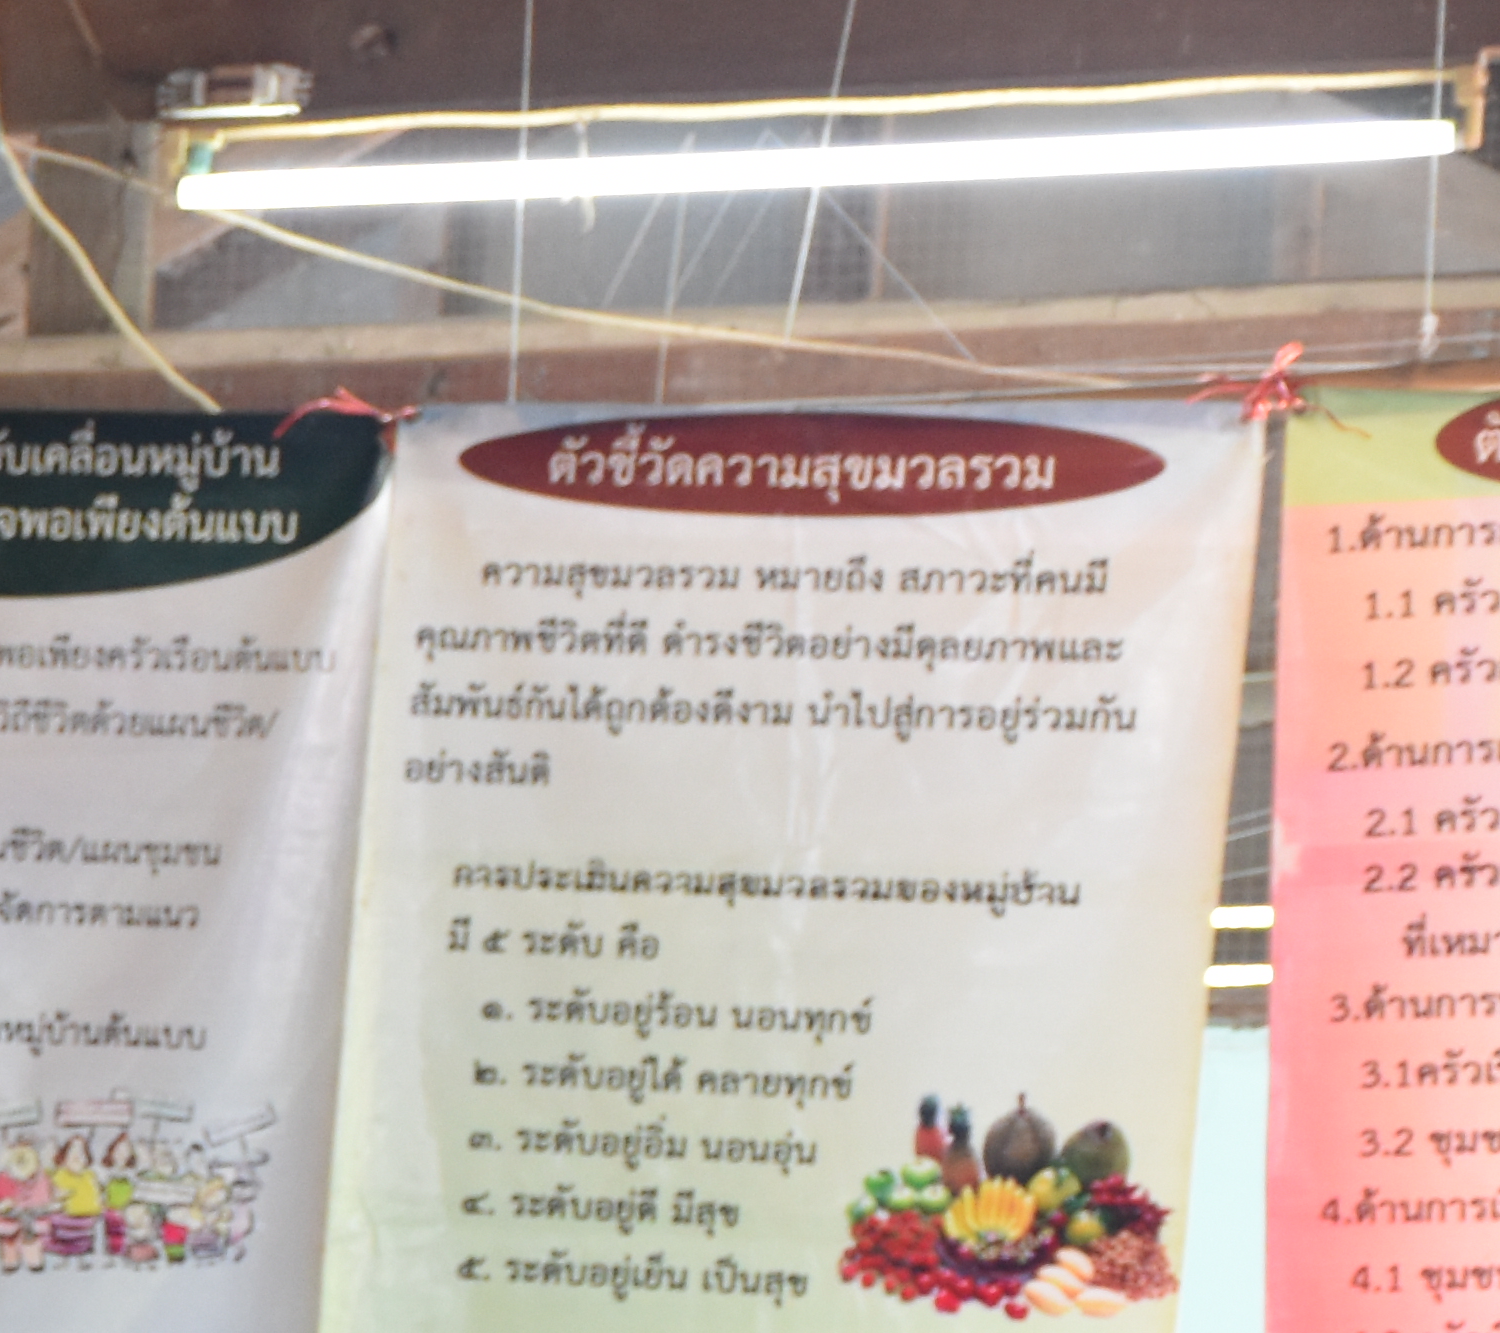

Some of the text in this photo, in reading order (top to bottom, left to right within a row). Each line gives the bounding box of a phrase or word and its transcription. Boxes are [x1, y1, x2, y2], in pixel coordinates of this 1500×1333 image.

[546, 423, 1057, 505] ตัวชี้วัดความสุขมวลรวม
[1326, 513, 1500, 555] 1.ด้านการ
[480, 549, 1108, 600] ความสุขมวลรวม หมายถึง สภาวะที่คนมี
[1365, 588, 1416, 621] 1.1
[415, 608, 649, 660] คุณภาพชีวิตที่ดี
[1361, 648, 1500, 692] 1.2 ครัว
[807, 686, 1137, 745] นำไปสู่การอยู่ร่วมกัน
[404, 746, 552, 788] อย่างสันติ
[1364, 807, 1417, 839] 2.1
[1362, 862, 1419, 894] 2.2
[522, 921, 604, 961] ระดับ
[616, 922, 660, 963] คือ
[529, 988, 719, 1041] ระดับอยู่ร้อน
[732, 996, 874, 1047] นอนทุกข์
[1330, 983, 1500, 1024] 3.ด้านการ
[522, 1053, 686, 1106] ระดับอยู่ได้
[695, 1063, 855, 1111] คลายทุกข์
[515, 1115, 688, 1171] ระดับอยู่อิ่ม
[701, 1129, 819, 1178] นอนอุ่น
[1358, 1127, 1414, 1158] 3.2
[510, 1185, 658, 1237] ระดับอยู่ดี
[672, 1191, 741, 1239] มีสุข
[505, 1246, 690, 1305] ระดับอยู่เย็น
[701, 1261, 810, 1309] เป็นสุข
[1349, 1263, 1404, 1295] 4.1
